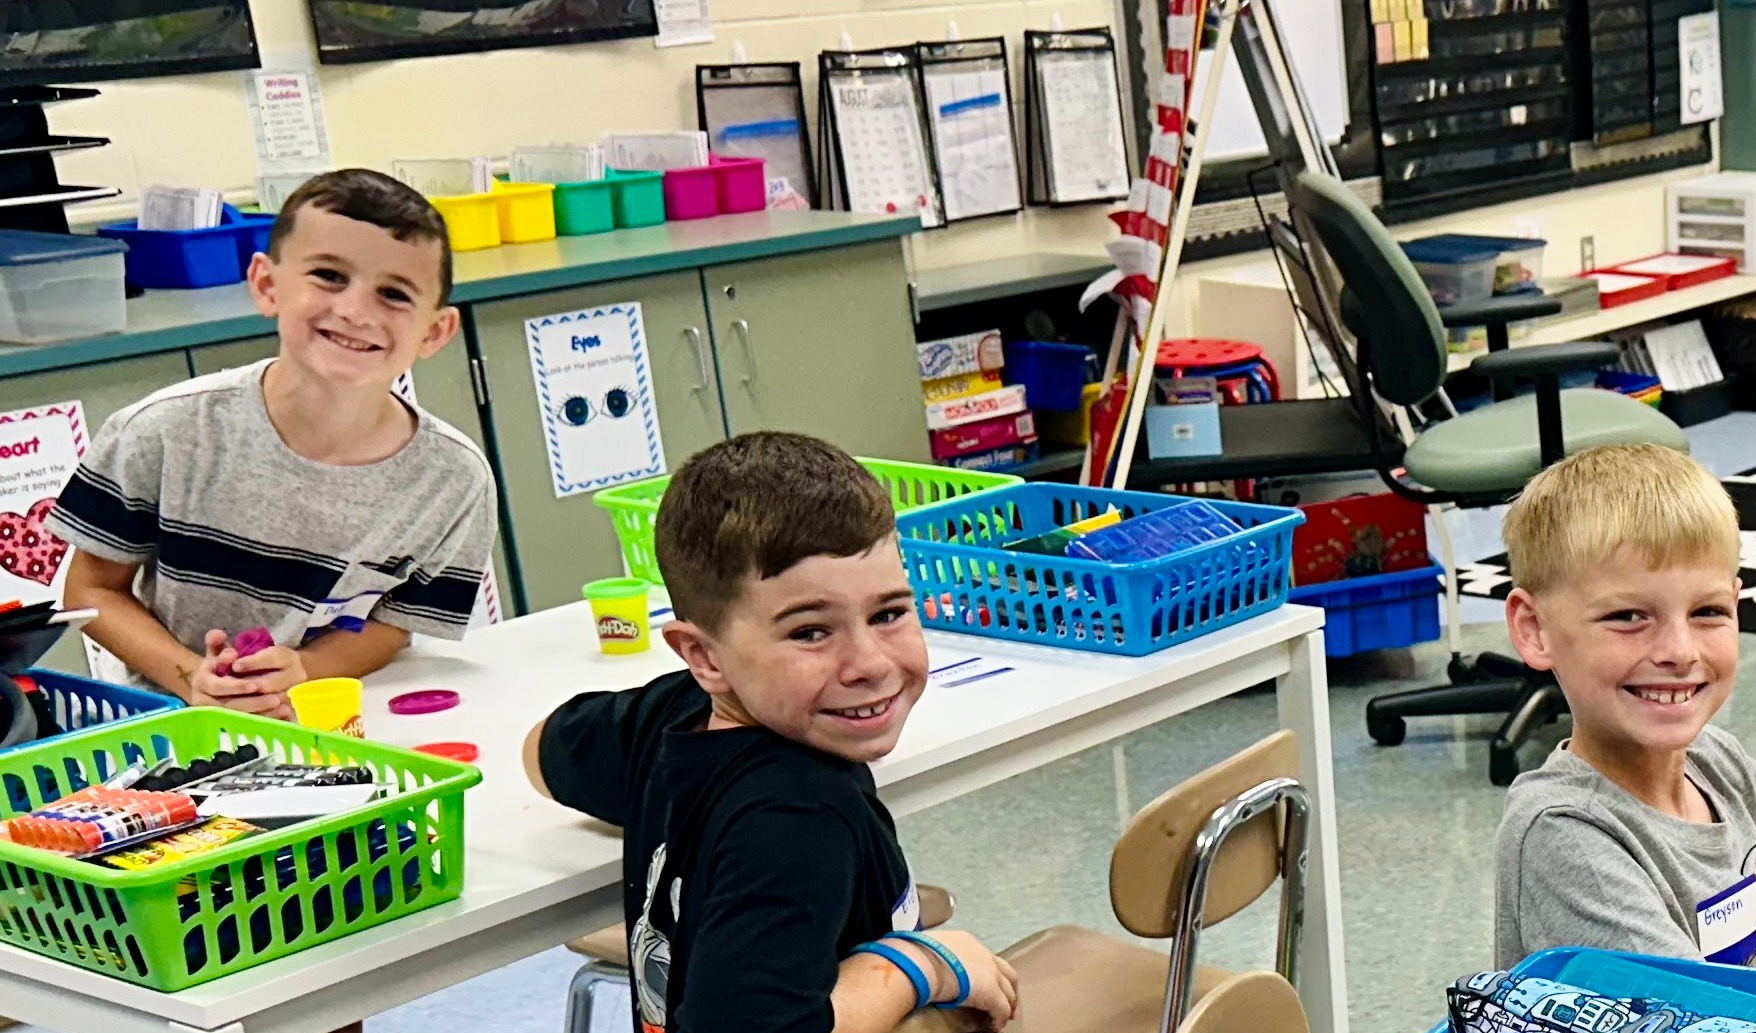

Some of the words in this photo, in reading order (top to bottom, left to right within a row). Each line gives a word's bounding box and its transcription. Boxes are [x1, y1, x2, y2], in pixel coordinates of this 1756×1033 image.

[264, 78, 298, 87] Writing
[266, 91, 301, 100] Caddies
[571, 335, 601, 353] Eyes
[24, 466, 47, 478] what
[50, 464, 65, 473] the
[1704, 898, 1743, 926] Greyson
